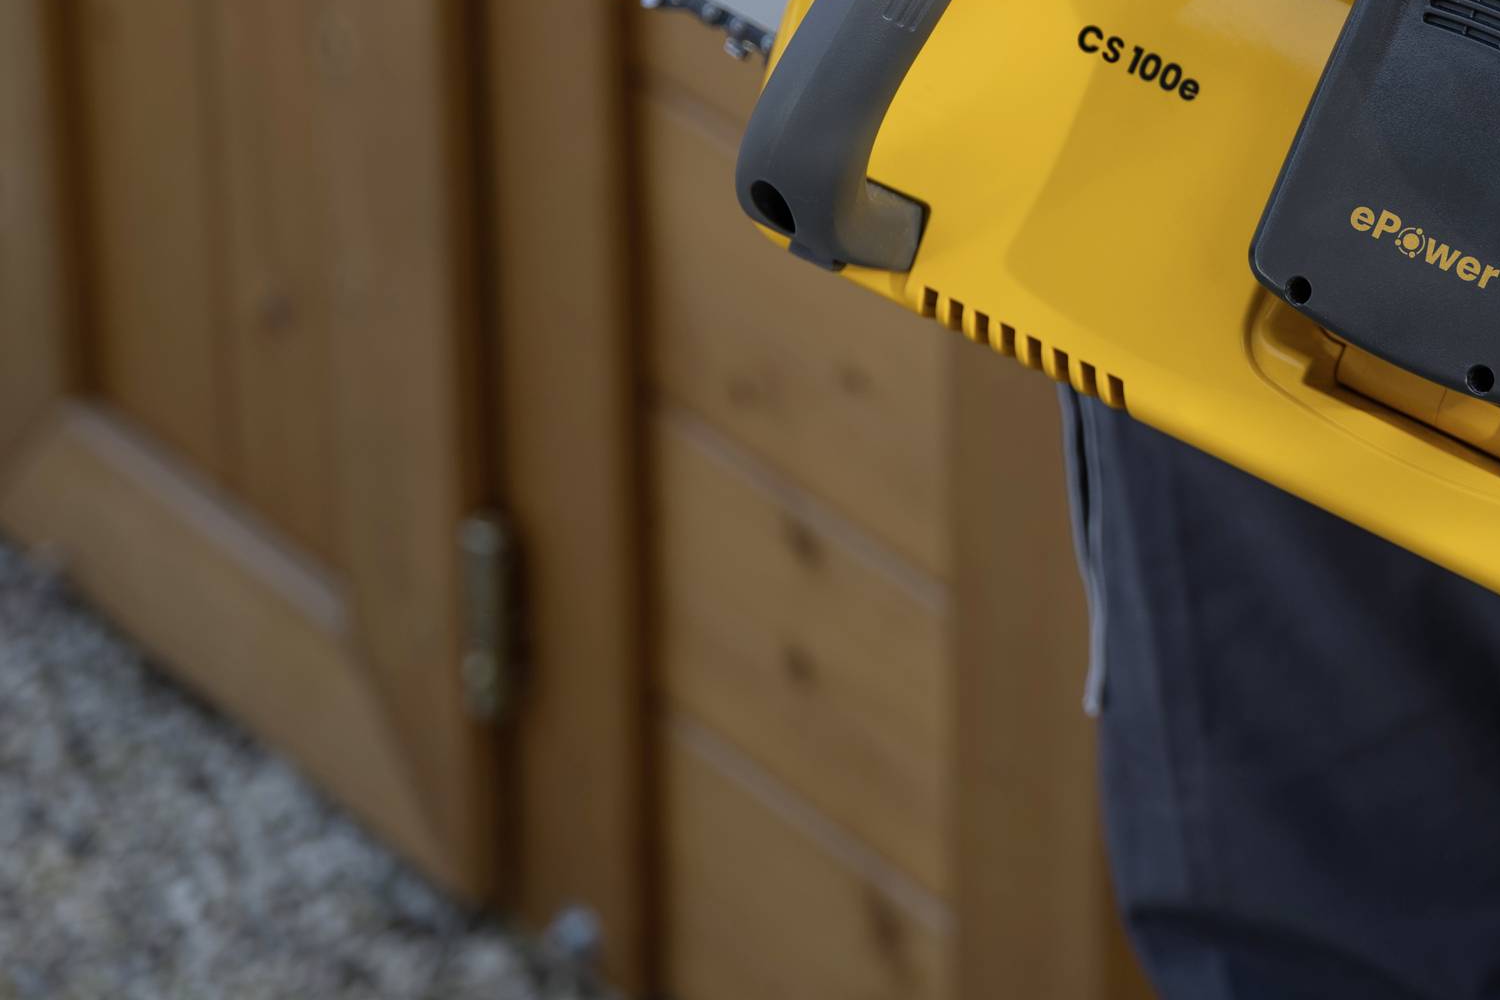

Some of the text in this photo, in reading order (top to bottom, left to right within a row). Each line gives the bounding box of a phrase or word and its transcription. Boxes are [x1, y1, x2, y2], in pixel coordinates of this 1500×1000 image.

[1077, 25, 1200, 101] CS 100e
[1350, 206, 1500, 289] ePower
